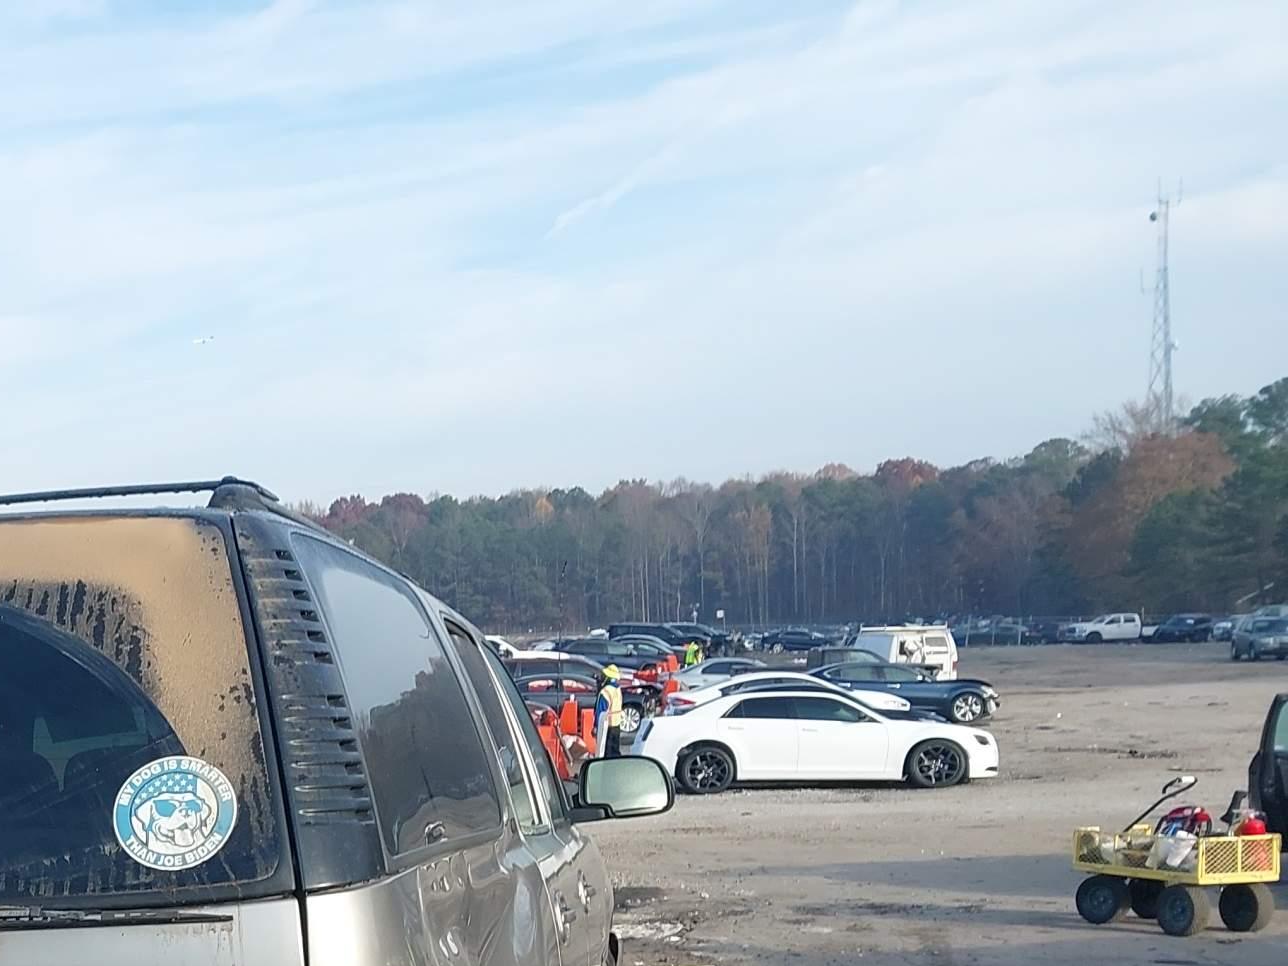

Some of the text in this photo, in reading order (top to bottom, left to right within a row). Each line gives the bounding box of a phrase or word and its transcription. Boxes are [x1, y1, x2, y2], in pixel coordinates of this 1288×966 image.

[119, 759, 232, 806] MY DOG IS SMARTER
[125, 832, 223, 866] THAN JOE BIDEN
